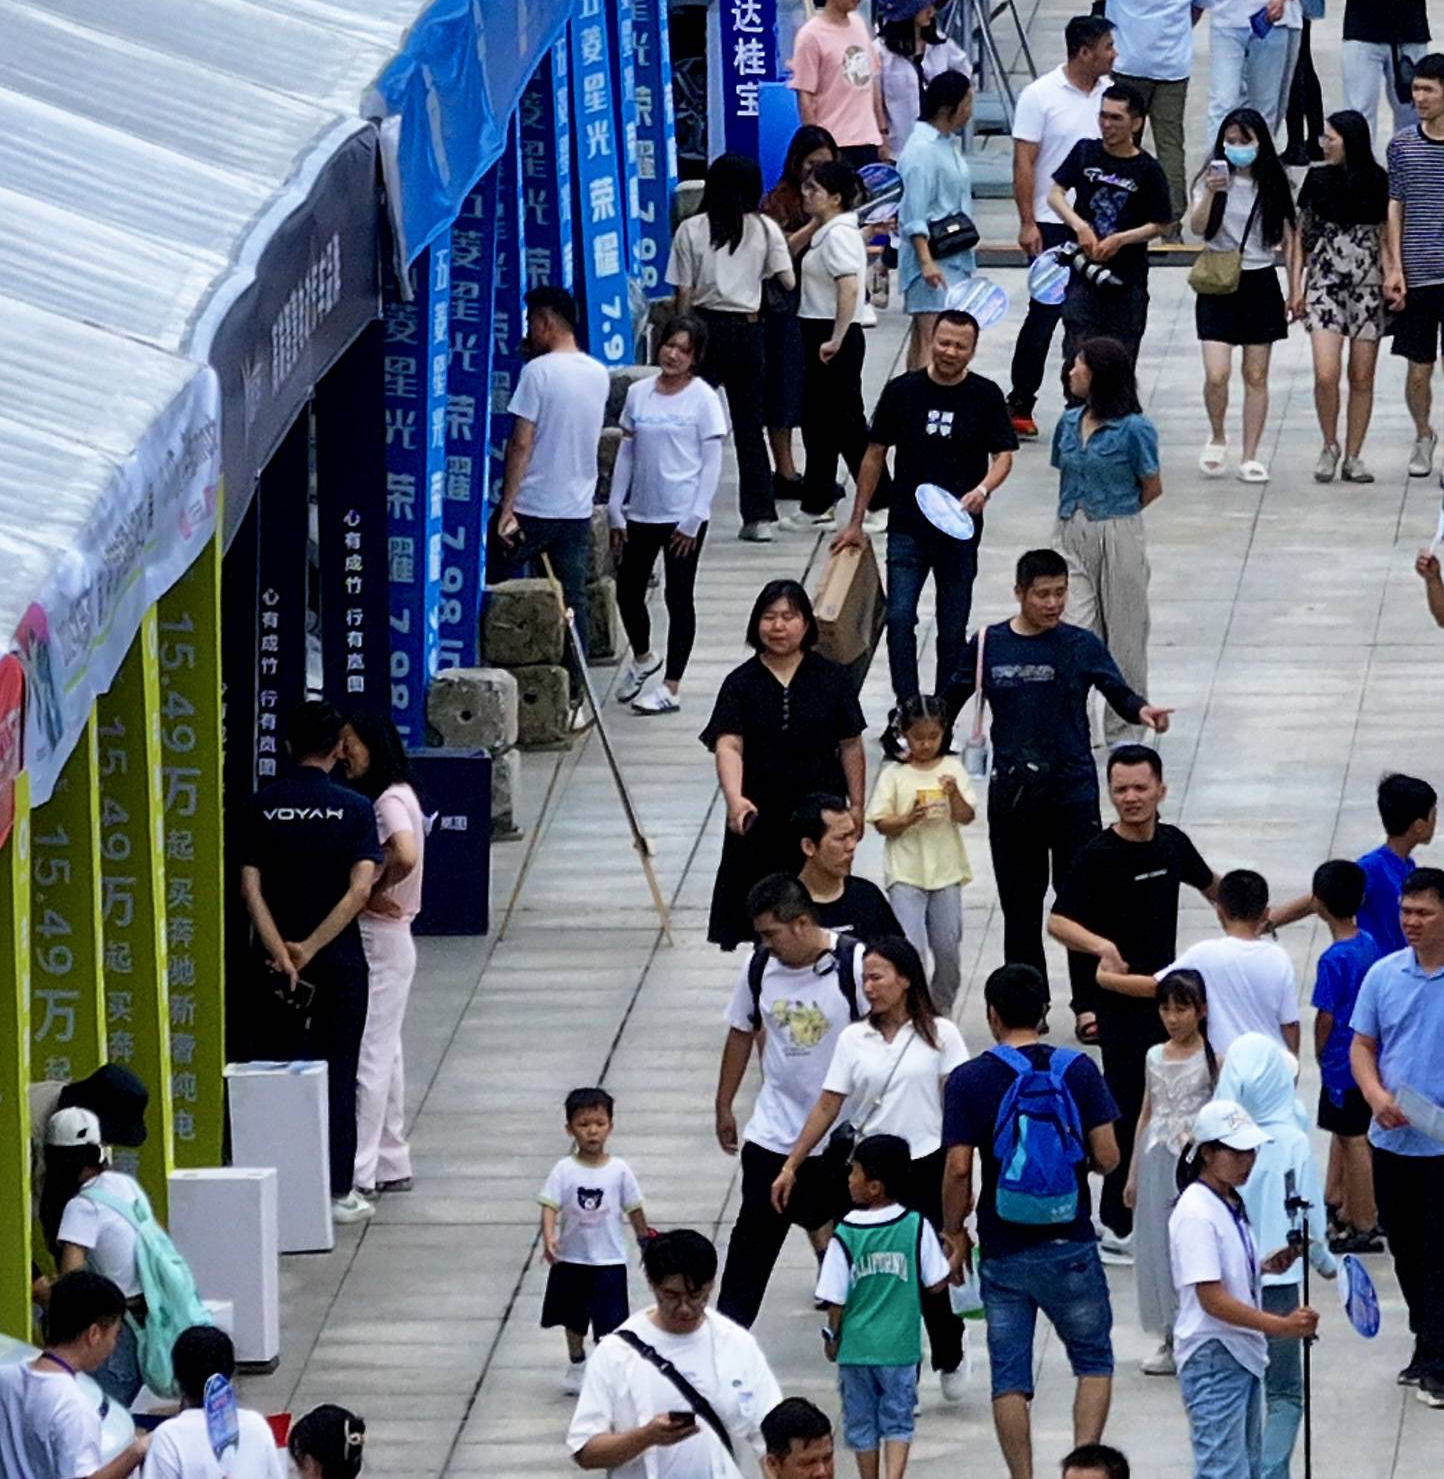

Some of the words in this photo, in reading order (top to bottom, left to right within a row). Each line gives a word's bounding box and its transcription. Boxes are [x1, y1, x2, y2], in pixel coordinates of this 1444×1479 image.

[343, 508, 364, 595] 心有成竹
[261, 587, 280, 675] 心有成竹
[345, 607, 366, 694] 行有岚图
[259, 689, 279, 777] 行有岚图
[263, 808, 345, 821] VOYAH
